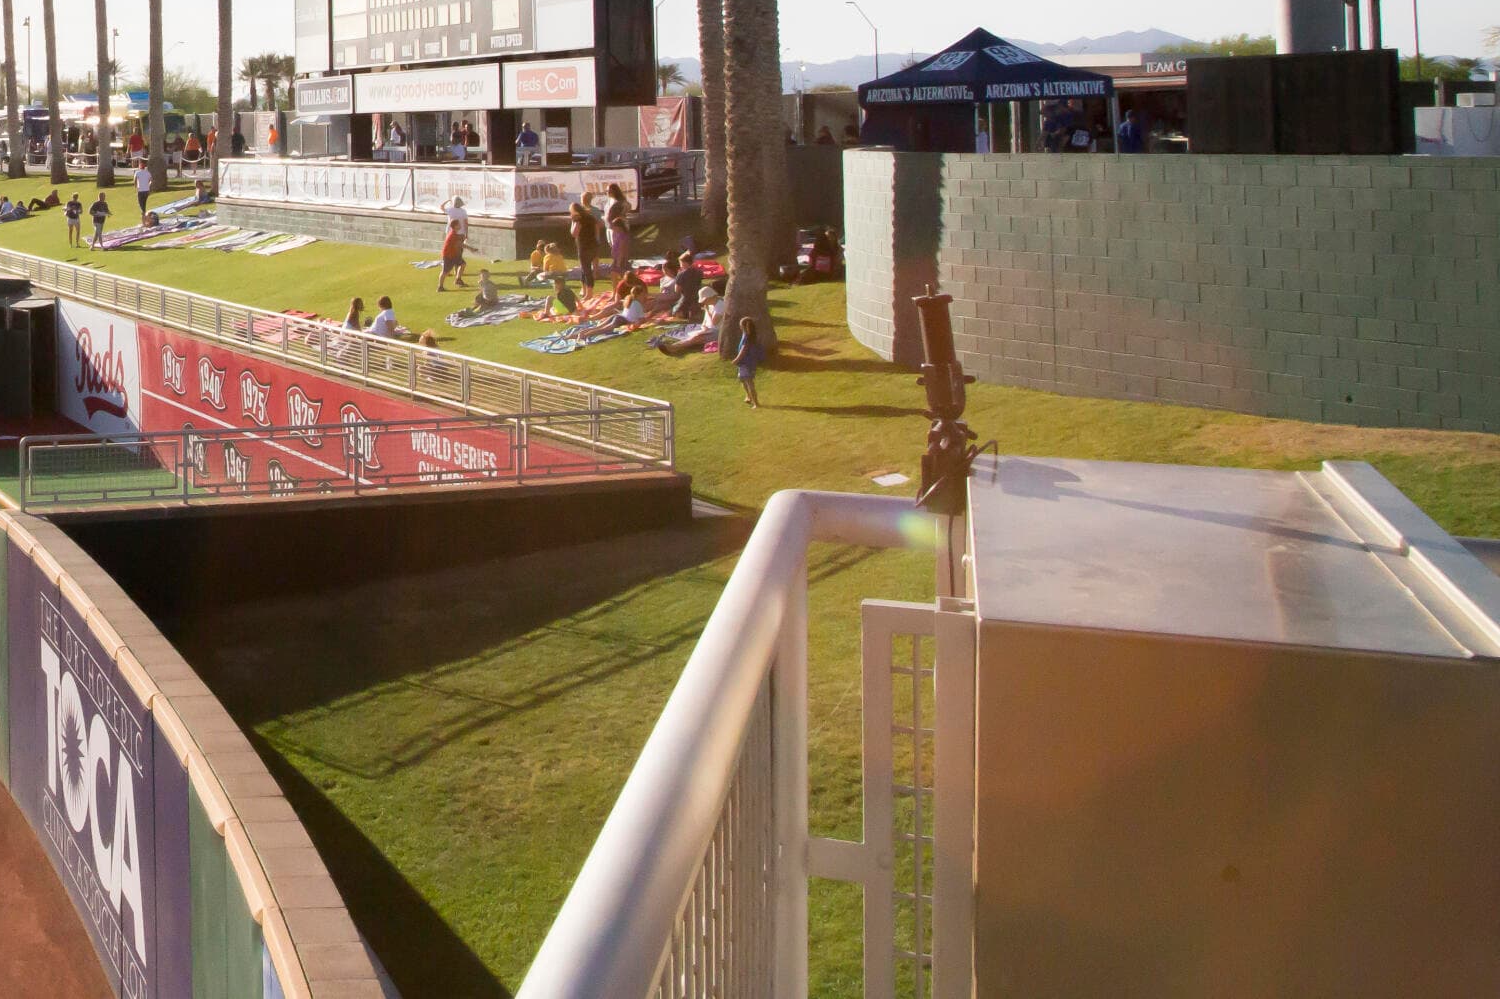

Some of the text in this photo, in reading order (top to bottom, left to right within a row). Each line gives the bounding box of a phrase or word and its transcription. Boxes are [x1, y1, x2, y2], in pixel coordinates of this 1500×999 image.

[986, 83, 1040, 98] ARIZONA'S
[1043, 80, 1105, 96] ALTERNATIVE
[1146, 62, 1174, 73] TEAM
[368, 79, 484, 102] www.goodyearaz.gov
[866, 88, 911, 102] ARIZONA'S
[913, 85, 968, 101] ALTERNATIVE
[514, 183, 566, 203] BLONDE
[74, 324, 129, 412] Reds
[163, 350, 181, 389] 1919
[200, 362, 220, 404] 1940
[242, 377, 265, 422] 1975
[290, 394, 315, 441] 1976
[225, 447, 246, 492] 1961
[411, 427, 498, 477] WORLD SERIES
[41, 597, 143, 771] THE ORTHOPEDIC
[40, 636, 147, 967] TOCA
[43, 794, 73, 869] CLINIC
